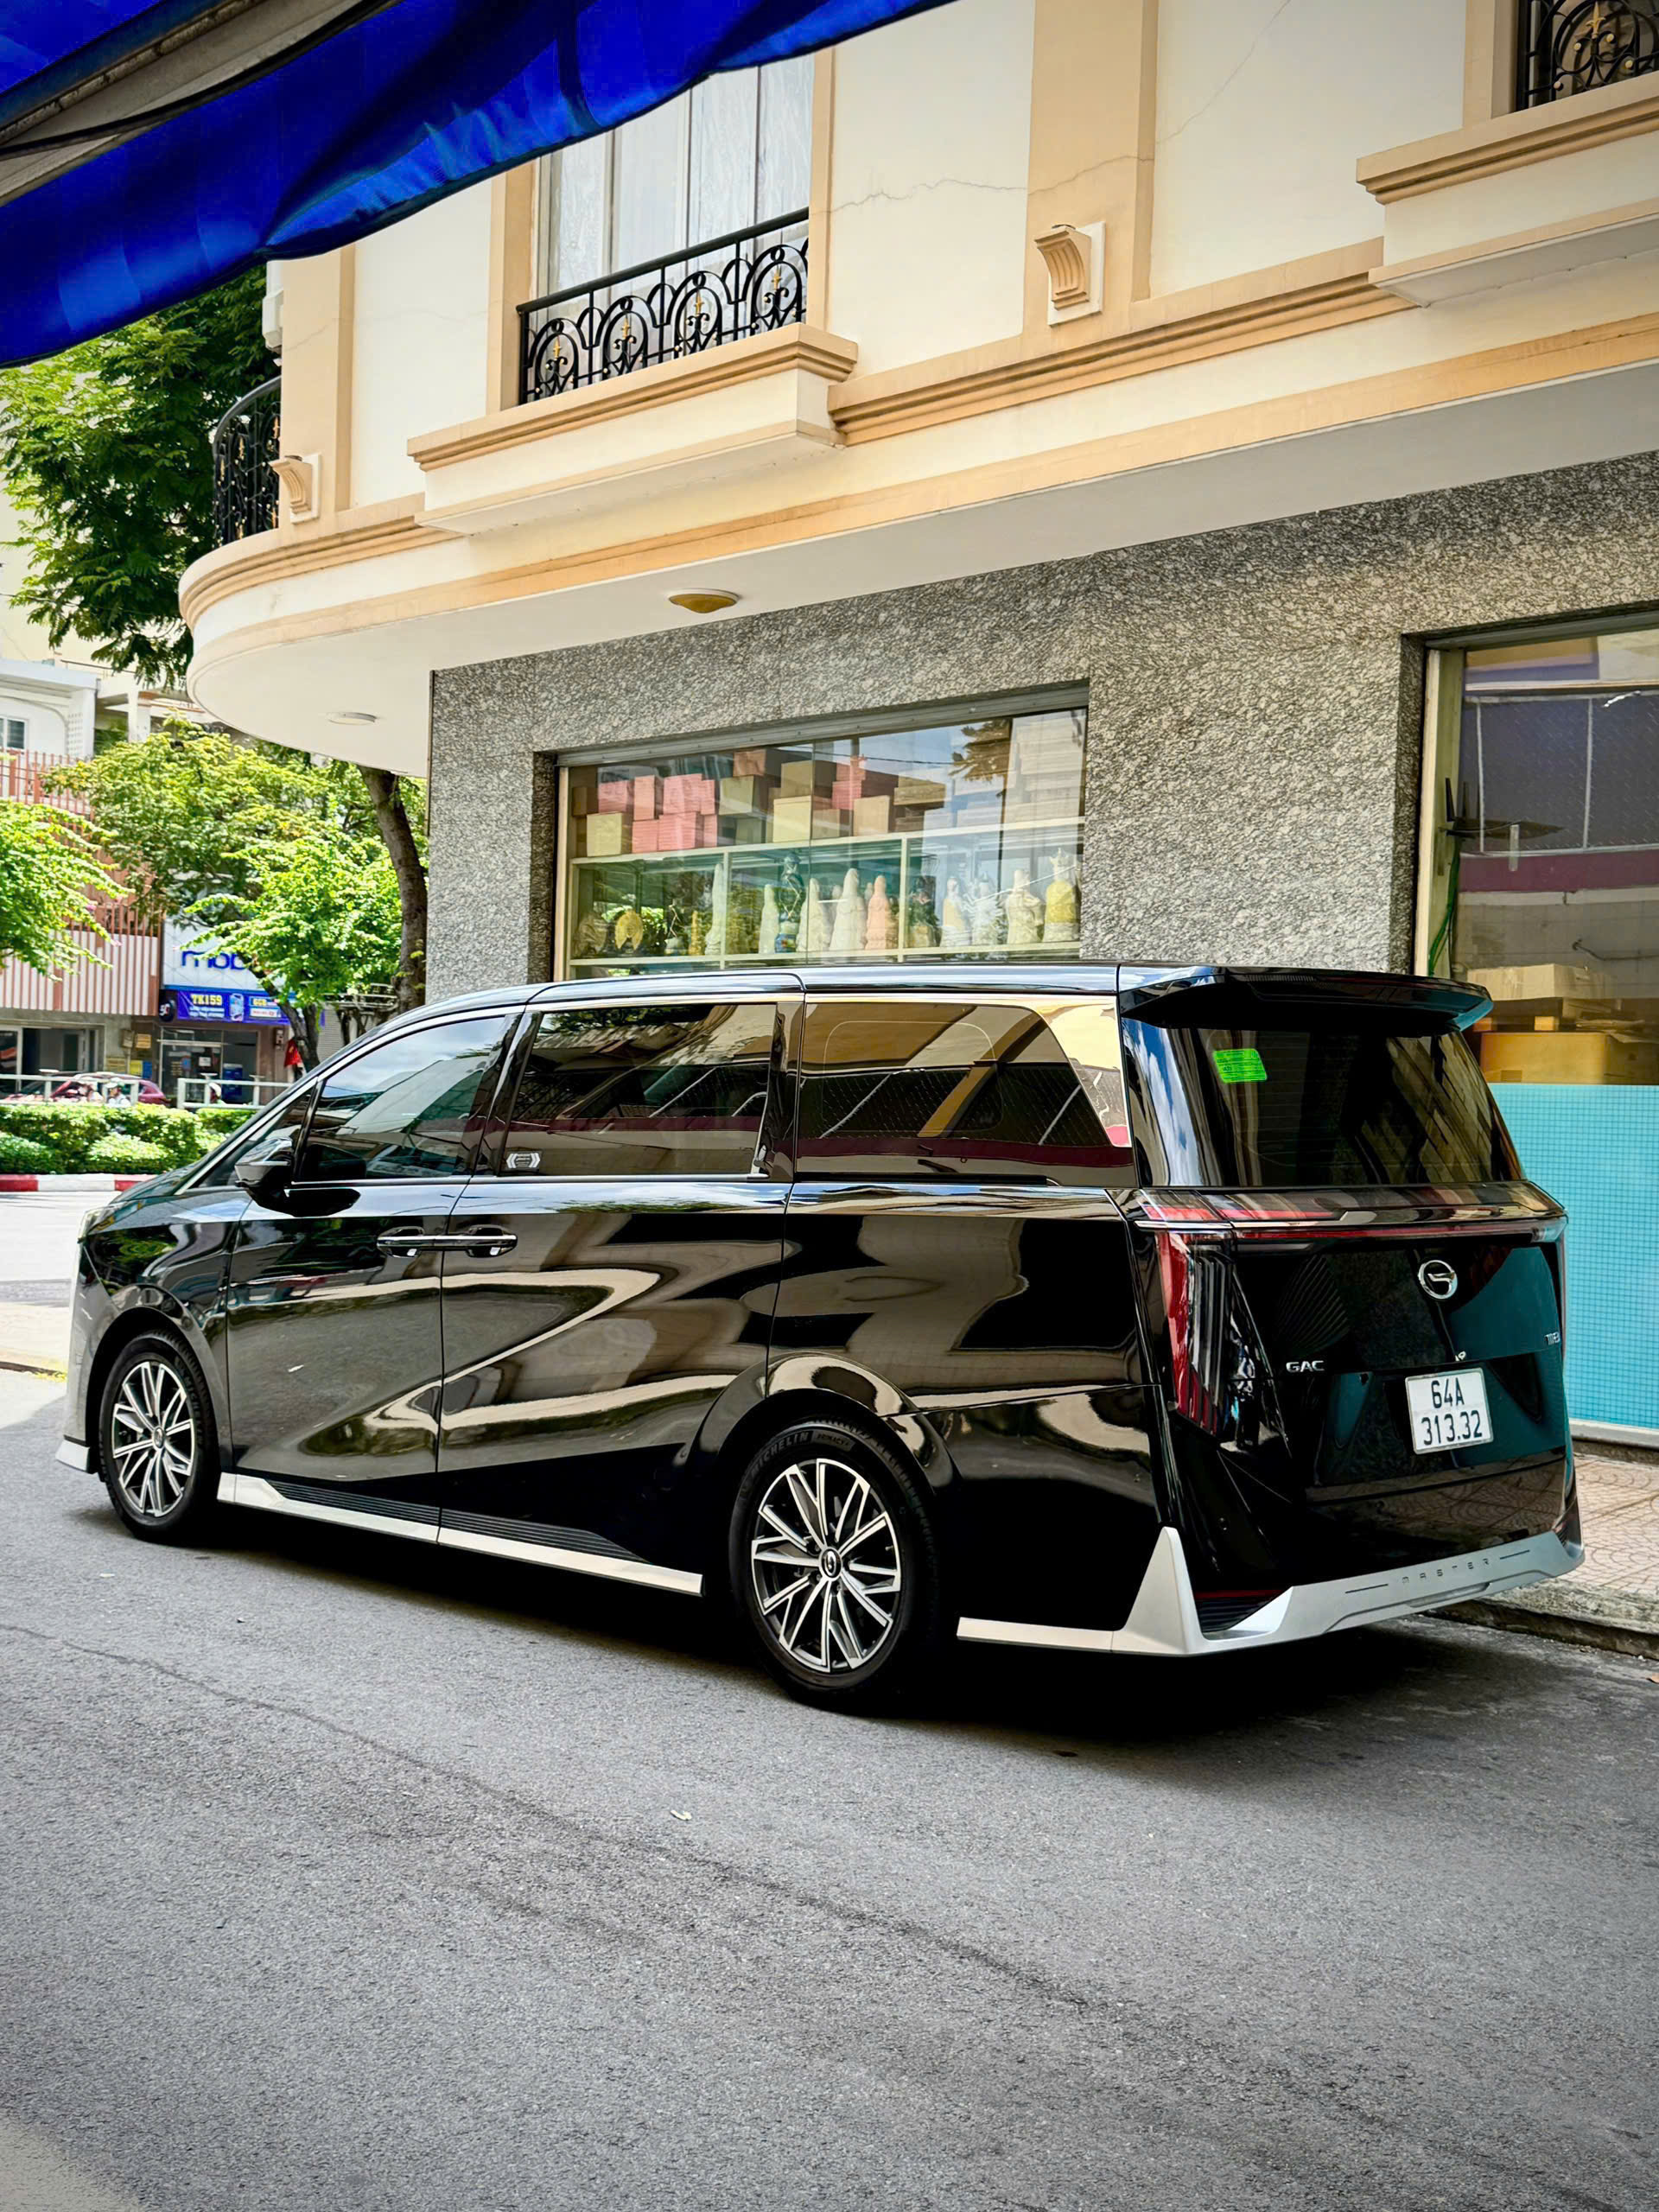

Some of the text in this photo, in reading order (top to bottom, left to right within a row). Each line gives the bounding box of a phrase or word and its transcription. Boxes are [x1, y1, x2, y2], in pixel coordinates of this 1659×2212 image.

[1286, 1360, 1325, 1373] GAC
[1431, 1377, 1465, 1408] 64A
[1421, 1409, 1483, 1446] 313.32
[750, 1431, 810, 1479] MICHELIN
[1402, 1558, 1490, 1585] MASTER
